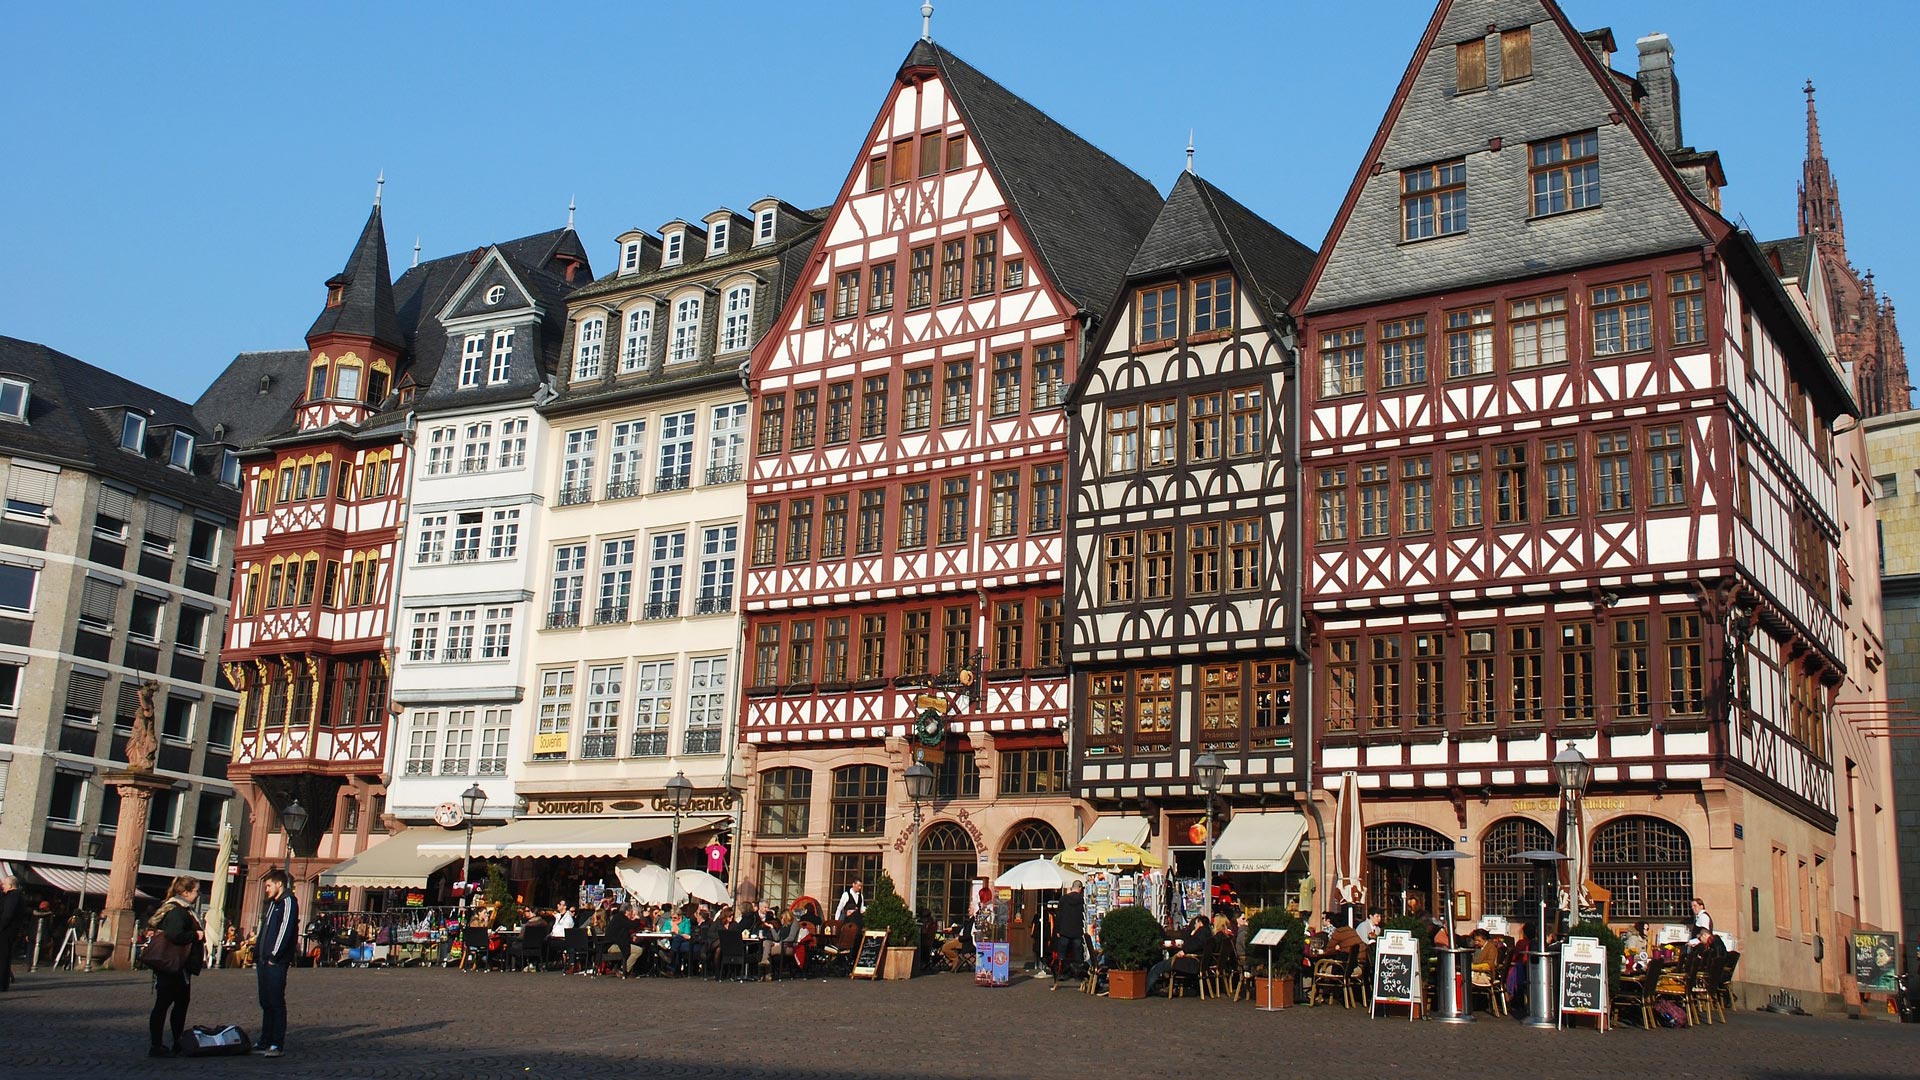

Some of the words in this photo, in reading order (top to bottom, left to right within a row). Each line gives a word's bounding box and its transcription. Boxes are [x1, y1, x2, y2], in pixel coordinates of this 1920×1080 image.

[1204, 730, 1234, 739] Präsente
[1252, 727, 1290, 738] Volkskunst
[1093, 736, 1117, 745] Bembel
[537, 798, 604, 814] Souvenirs
[957, 807, 989, 854] Bembel
[1242, 863, 1254, 871] FAN
[1256, 863, 1271, 871] SHOP
[1855, 935, 1879, 948] ESPRIT
[1380, 970, 1396, 978] oder
[1569, 981, 1582, 989] mit
